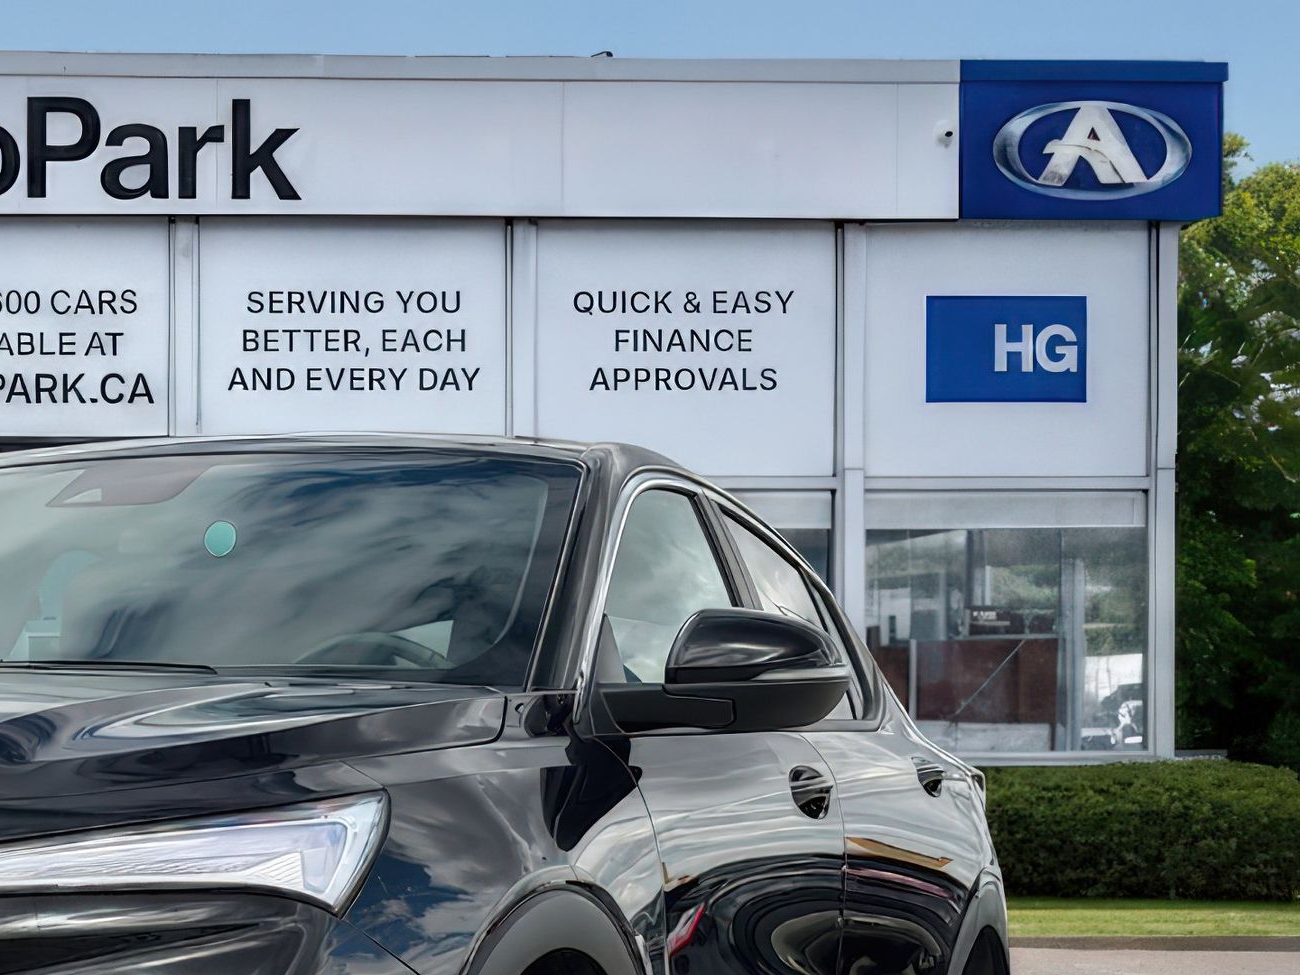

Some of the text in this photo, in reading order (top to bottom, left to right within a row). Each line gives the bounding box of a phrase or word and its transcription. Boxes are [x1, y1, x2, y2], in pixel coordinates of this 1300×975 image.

[50, 289, 138, 316] CARS
[246, 290, 461, 314] SERVING YOU
[573, 290, 795, 316] QUICK & EASY
[84, 331, 125, 357] AT
[242, 328, 466, 357] BETTER, EACH
[614, 328, 753, 353] FINANCE
[993, 323, 1078, 373] HG
[227, 367, 481, 392] AND EVERY DAY
[589, 367, 778, 392] APPROVALS
